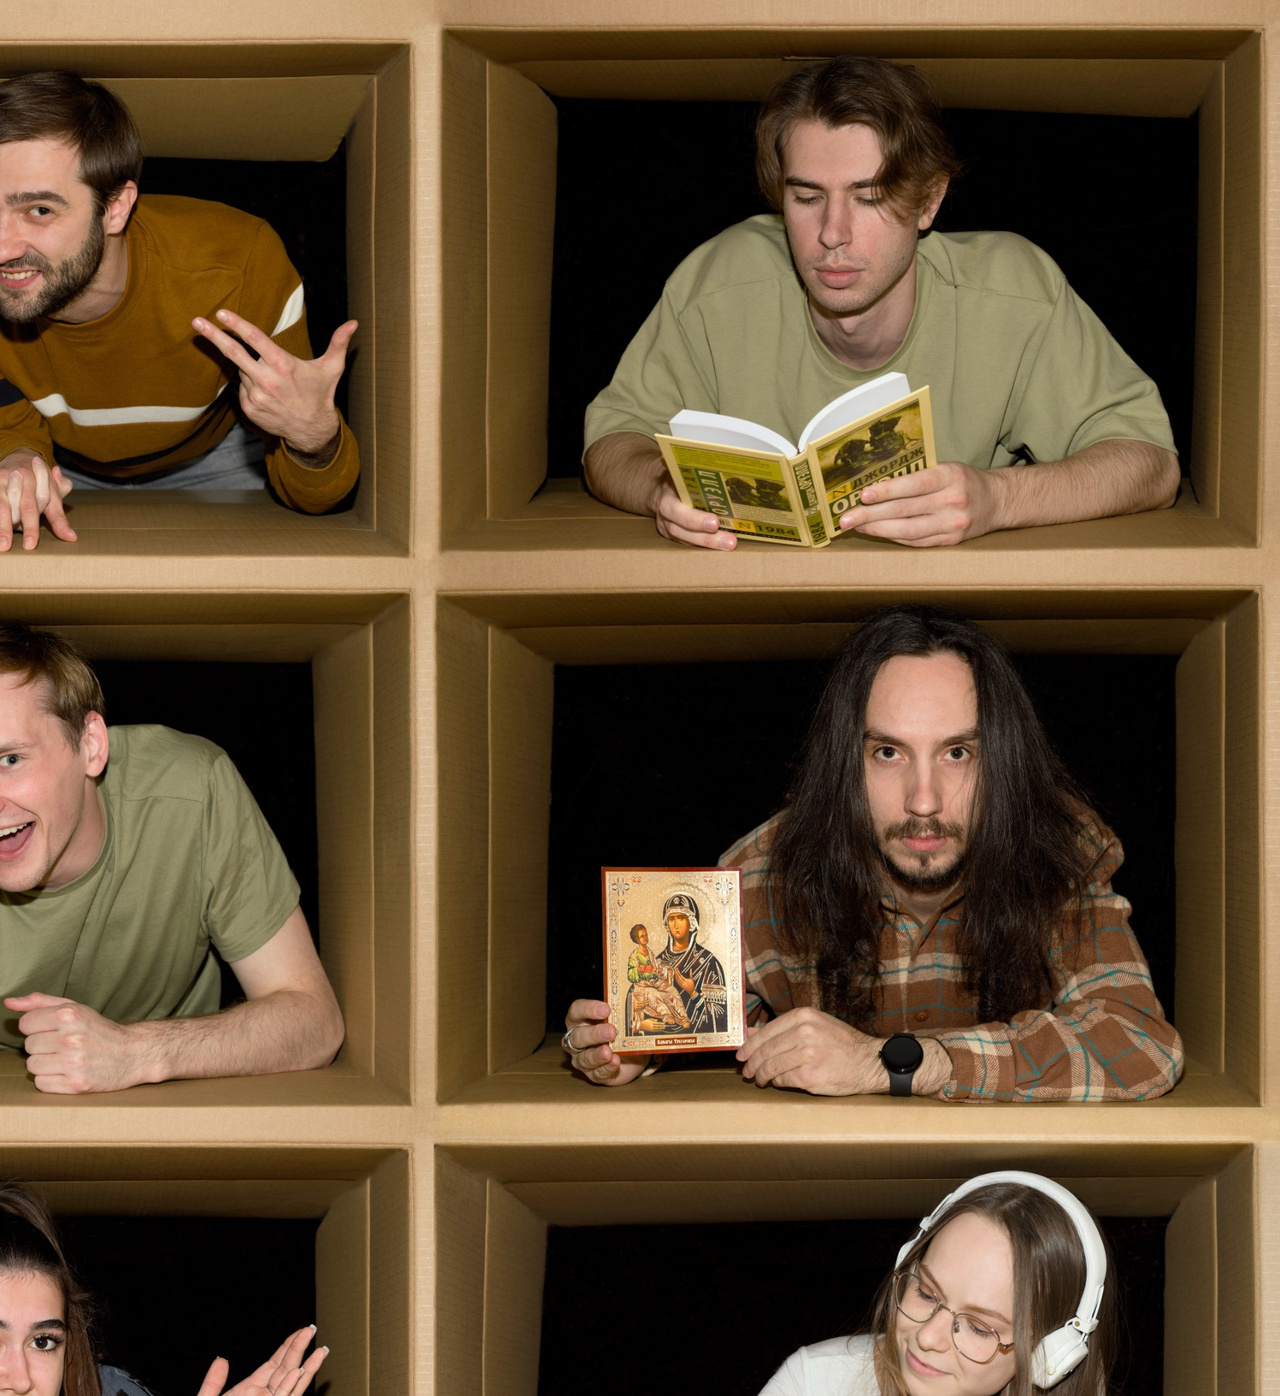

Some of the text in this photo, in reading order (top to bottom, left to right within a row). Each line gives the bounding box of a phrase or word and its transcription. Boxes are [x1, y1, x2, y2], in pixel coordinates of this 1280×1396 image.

[853, 446, 924, 487] ДЖОРДЖ
[702, 470, 729, 516] ОРУЭЛЛ
[756, 523, 796, 536] 1984
[810, 521, 826, 543] 1984
